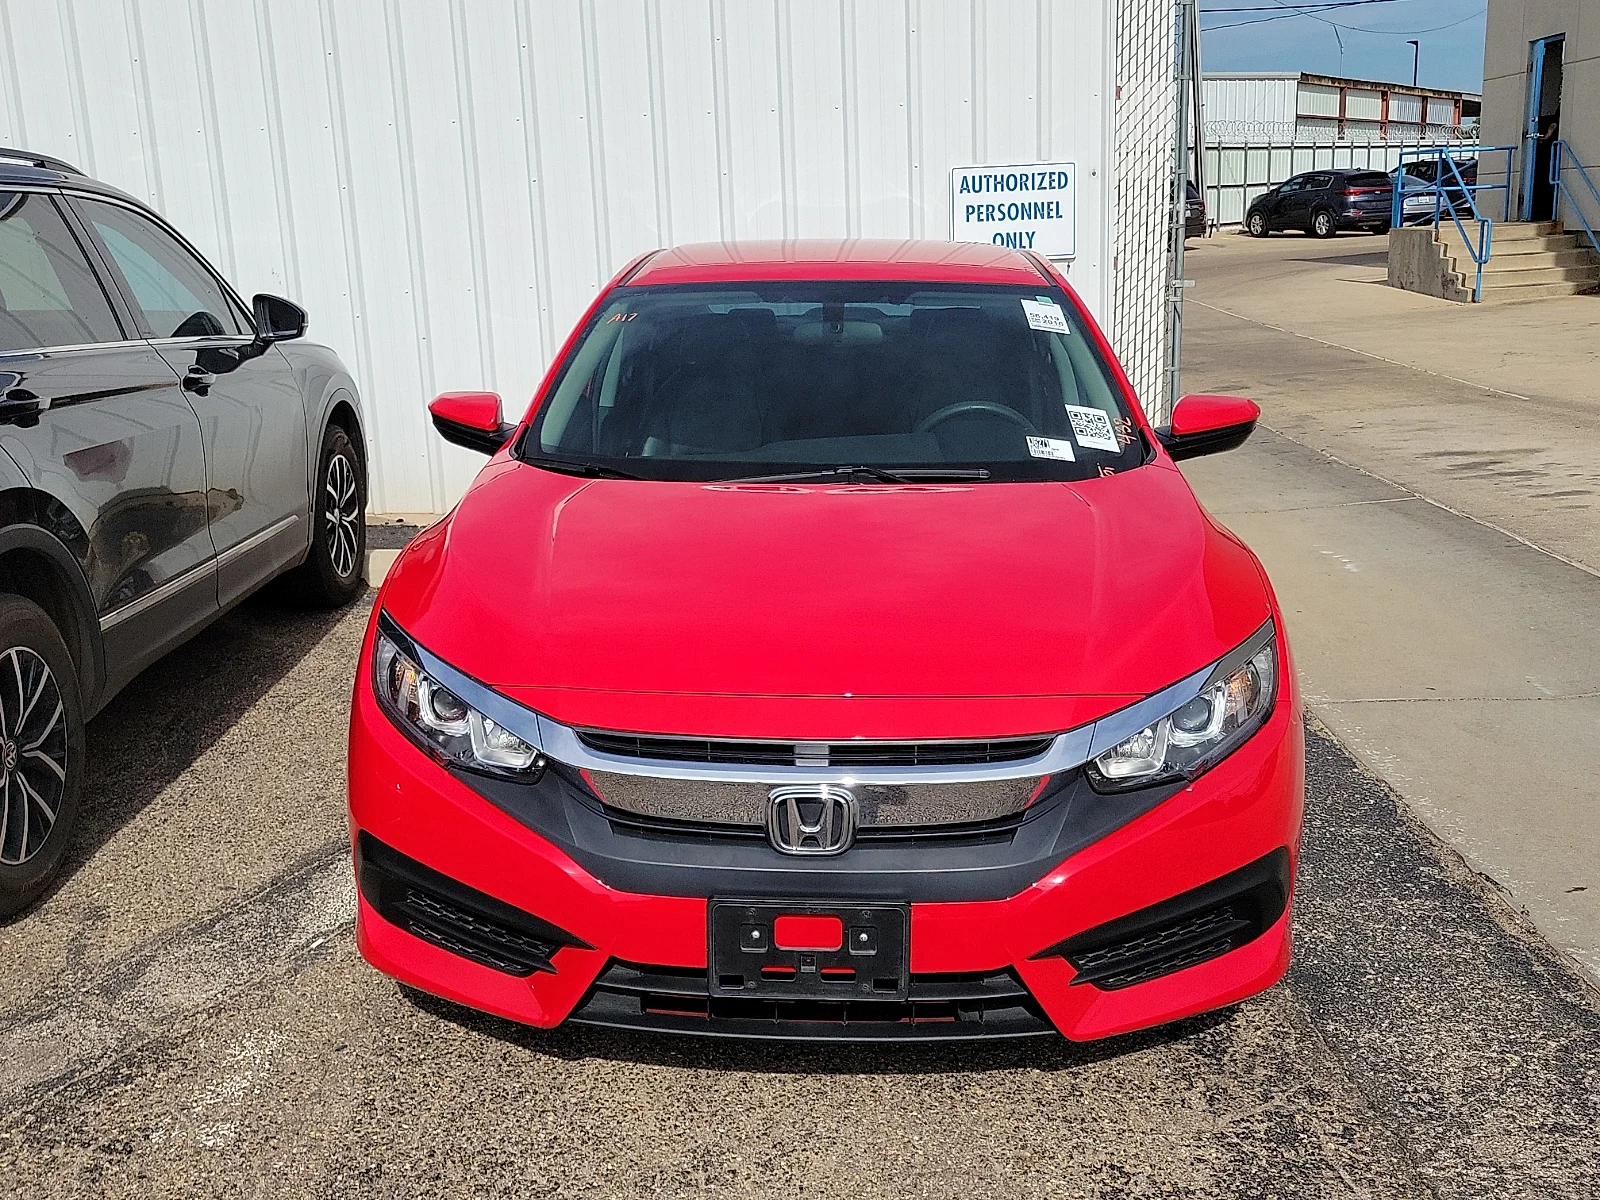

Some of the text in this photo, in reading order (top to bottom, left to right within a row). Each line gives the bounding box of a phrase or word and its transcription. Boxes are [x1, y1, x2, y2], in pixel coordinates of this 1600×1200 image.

[959, 171, 1069, 194] AUTHORIZED
[965, 200, 1063, 223] PERSONNEL
[992, 231, 1036, 249] ONLY
